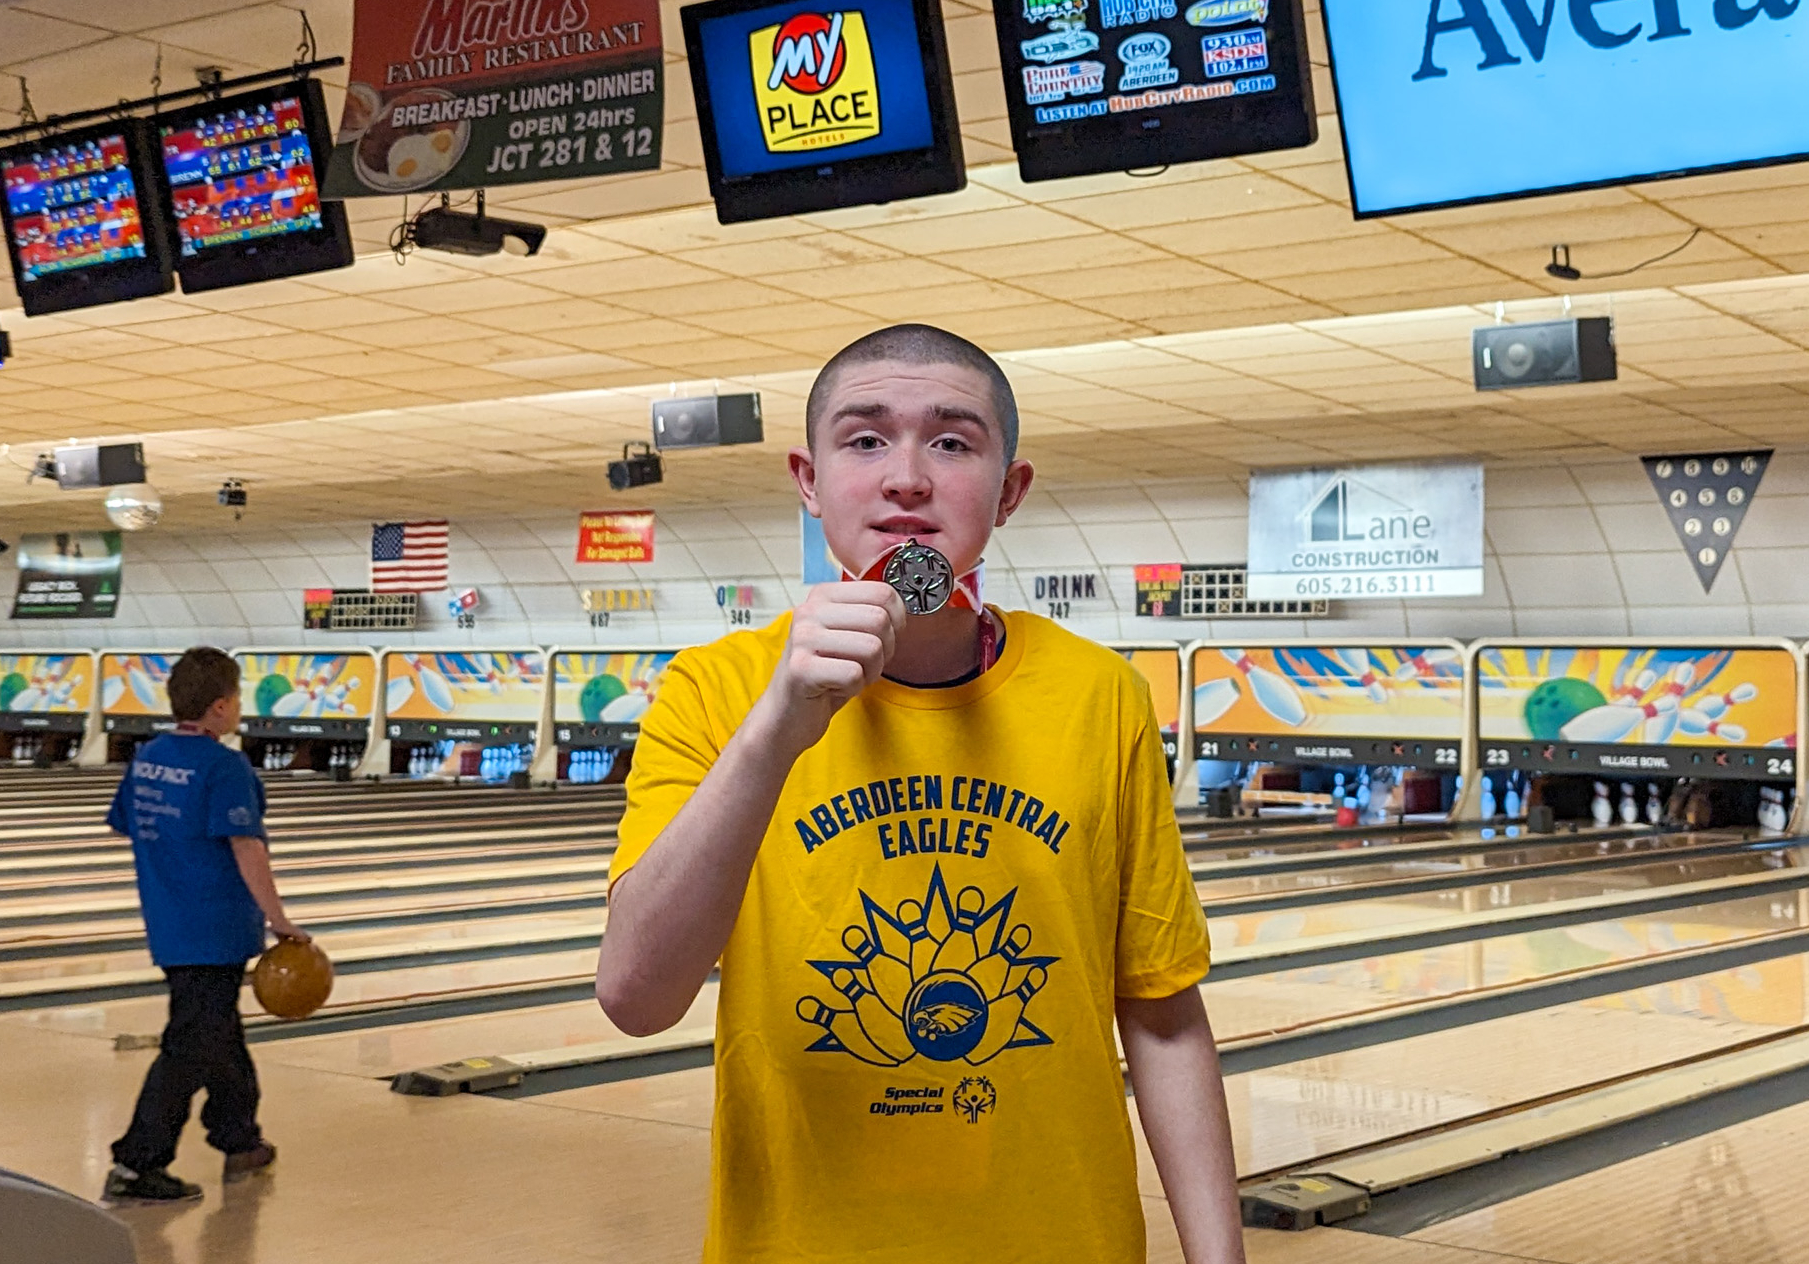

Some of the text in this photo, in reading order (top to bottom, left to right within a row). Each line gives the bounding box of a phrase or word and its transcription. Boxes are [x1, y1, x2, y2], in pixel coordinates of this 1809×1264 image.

[1103, 5, 1177, 27] RADIO
[387, 22, 645, 84] FAMILY RESTAURANT
[1132, 42, 1158, 56] FOX
[1026, 67, 1070, 84] PURE
[1122, 71, 1176, 89] ABERDEEN
[1028, 75, 1101, 95] COUNTRY
[767, 91, 872, 134] PLACE
[509, 107, 636, 140] OPEN 24hrs
[802, 133, 846, 146] HOTELS
[486, 127, 654, 173] JCT 281 & 12
[1342, 480, 1431, 541] Lane
[1291, 549, 1439, 568] CONSTRUCTION
[1035, 574, 1096, 600] DRINK
[1296, 575, 1436, 595] 605.216.3111
[731, 609, 751, 625] 349
[1049, 602, 1070, 619] 747
[1202, 742, 1219, 755] 21
[1295, 746, 1353, 757] VILLAGE BOWL
[1435, 749, 1457, 763] 22
[1486, 749, 1510, 764] 23
[1600, 755, 1668, 768] VILLAGE BOWL
[1767, 758, 1792, 774] 24
[794, 775, 1071, 855] ABERDEEN CENTRAL
[878, 818, 993, 860] EAGLES
[885, 1087, 945, 1101] Special
[869, 1102, 945, 1117] Olympics
